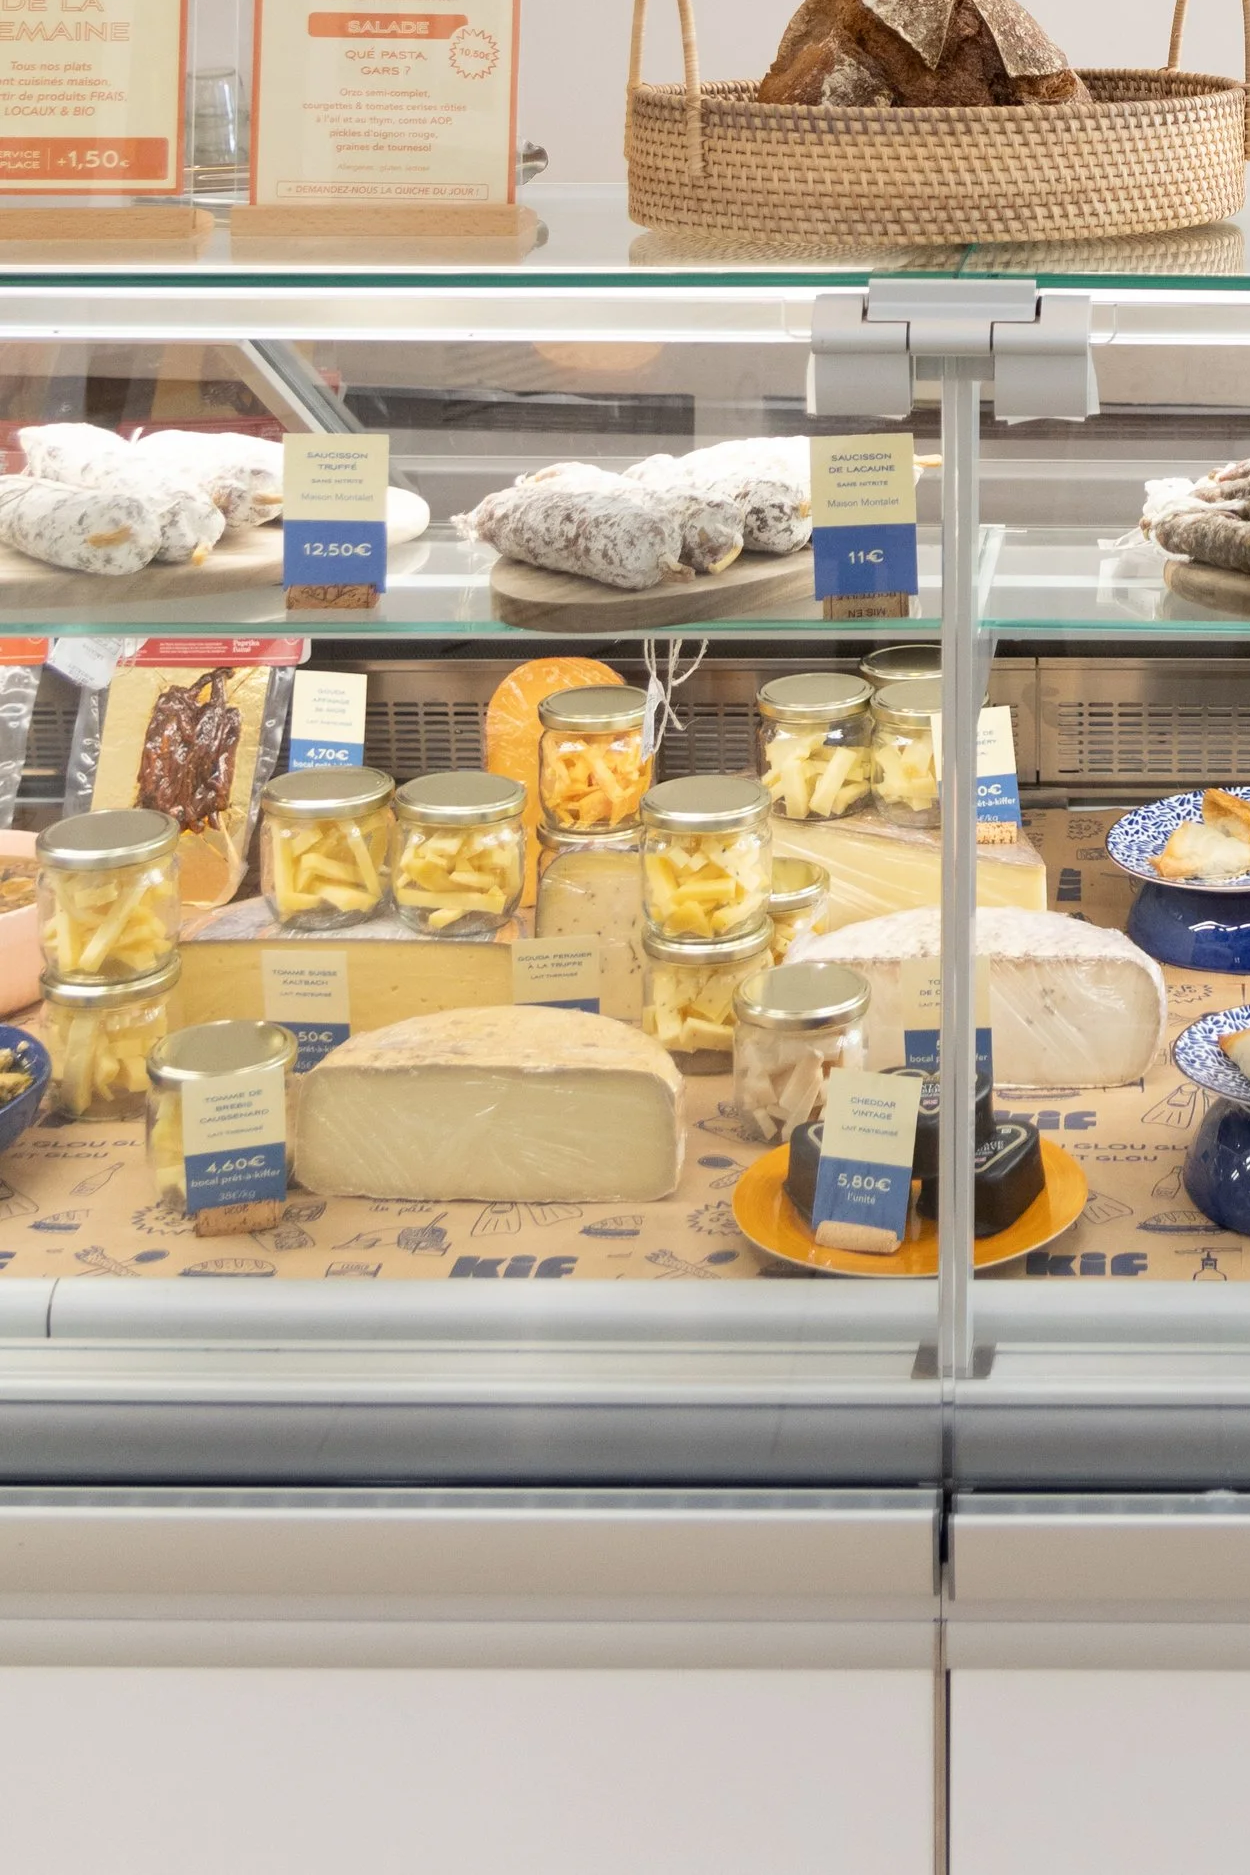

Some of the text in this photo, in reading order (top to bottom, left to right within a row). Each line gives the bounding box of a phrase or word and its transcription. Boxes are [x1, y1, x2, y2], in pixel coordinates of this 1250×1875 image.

[0, 21, 130, 42] EMAINE
[347, 20, 430, 35] SALADE
[345, 47, 375, 61] QUÉ
[11, 61, 92, 73] Tous nos plats
[361, 66, 400, 75] GARS
[4, 106, 95, 116] LOCAUX & BIO
[832, 453, 891, 461] SAUCISSON
[318, 463, 356, 471] TRUFFÉ
[846, 464, 895, 473] LACAUNE
[302, 493, 373, 501] Maison Montalet
[828, 497, 899, 508] Maison Montalet
[304, 543, 371, 557] 12,50€
[849, 549, 884, 564] 11€
[306, 748, 349, 760] 4,70€
[851, 1096, 896, 1109] CHEDDAR
[852, 1108, 892, 1121] VINTAGE
[205, 1155, 265, 1174] 4,60€
[191, 1177, 218, 1188] bocal
[838, 1173, 892, 1192] 5,80€
[847, 1192, 876, 1205] l'unité
